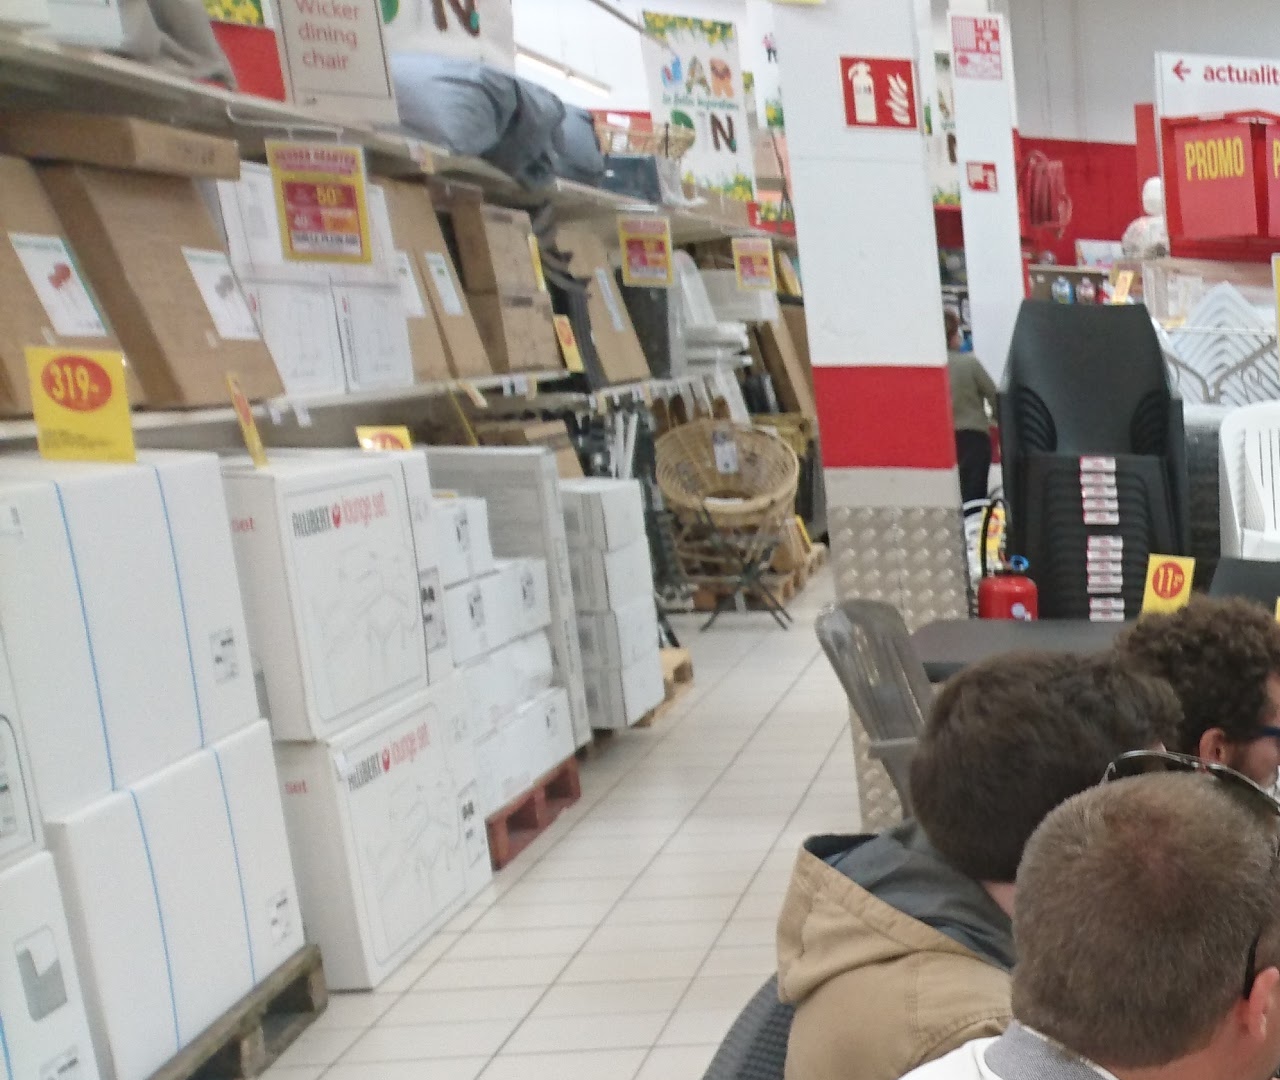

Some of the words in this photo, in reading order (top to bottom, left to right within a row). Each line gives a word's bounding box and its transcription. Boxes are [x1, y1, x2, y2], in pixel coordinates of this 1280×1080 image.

[299, 21, 357, 48] dining
[302, 49, 349, 70] chair
[1184, 136, 1245, 182] PROMO
